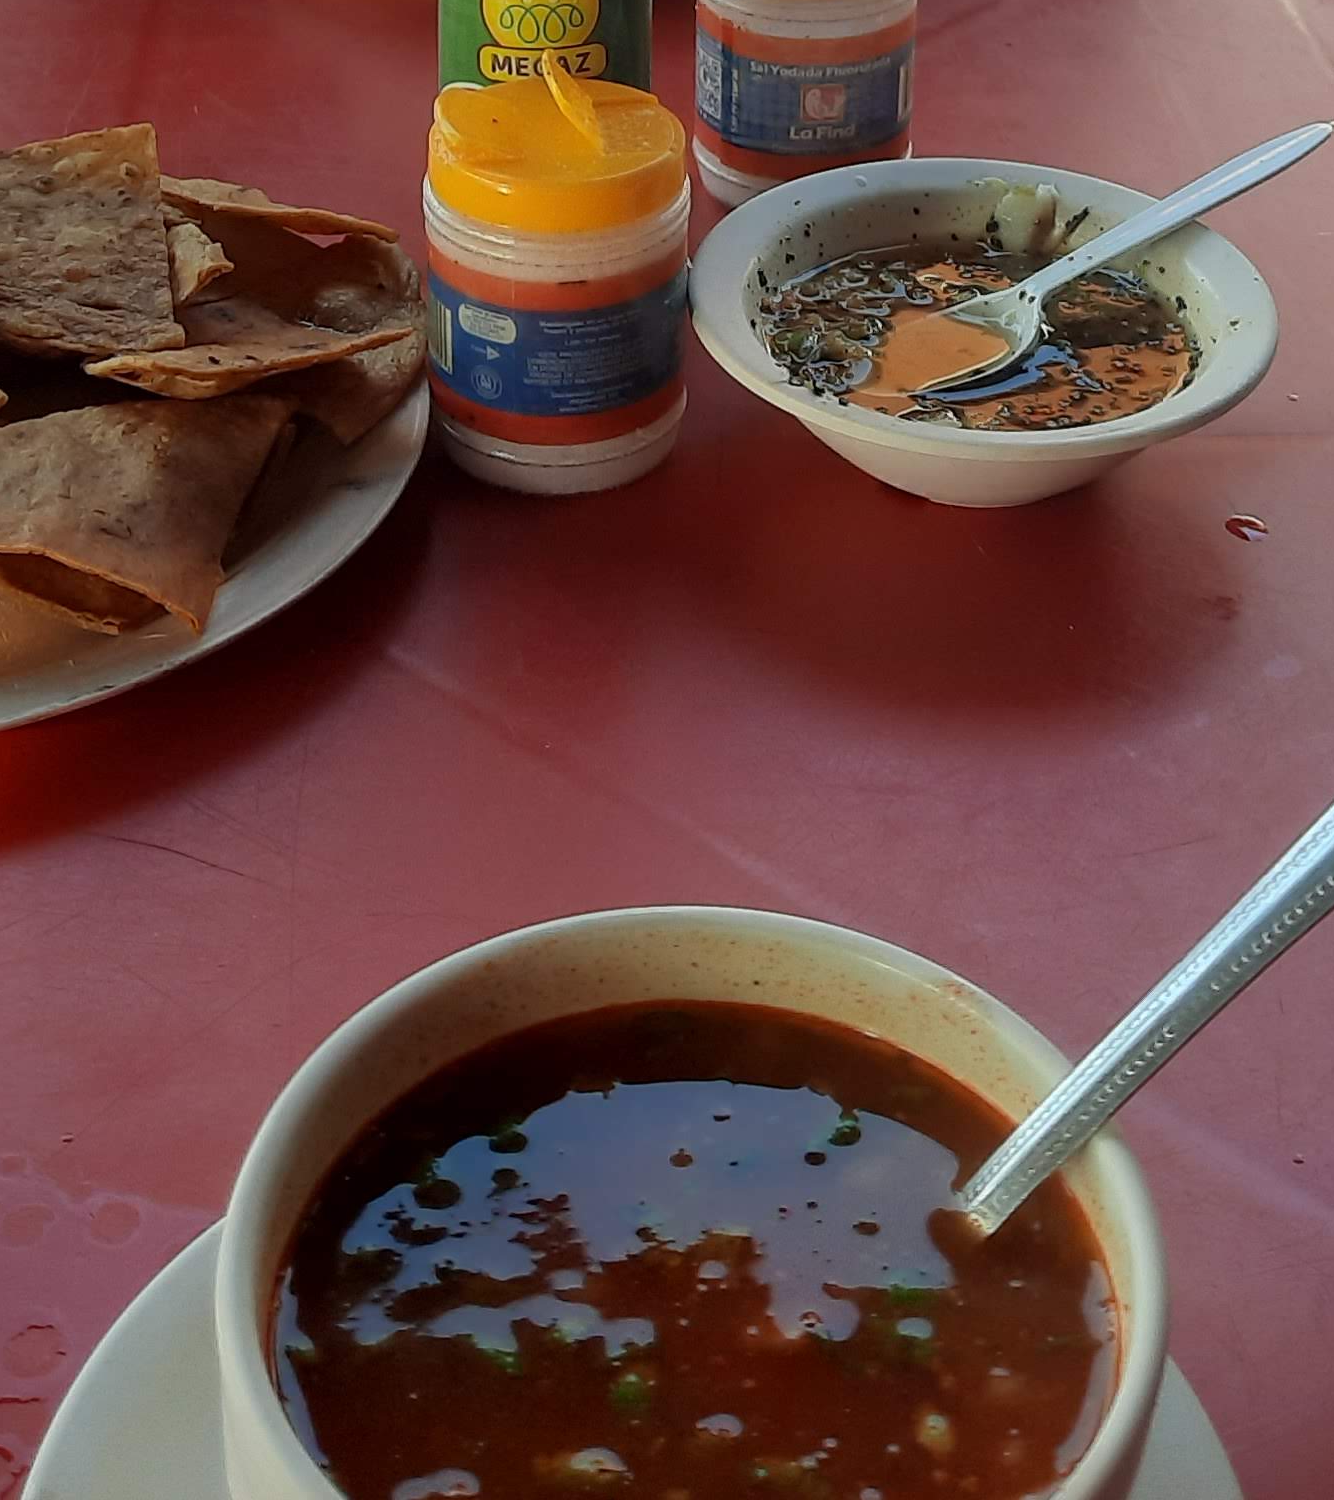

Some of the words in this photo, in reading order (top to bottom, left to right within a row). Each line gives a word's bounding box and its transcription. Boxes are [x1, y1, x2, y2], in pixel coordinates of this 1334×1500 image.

[749, 60, 768, 74] Sal
[770, 64, 822, 78] Yodada
[789, 125, 812, 140] La
